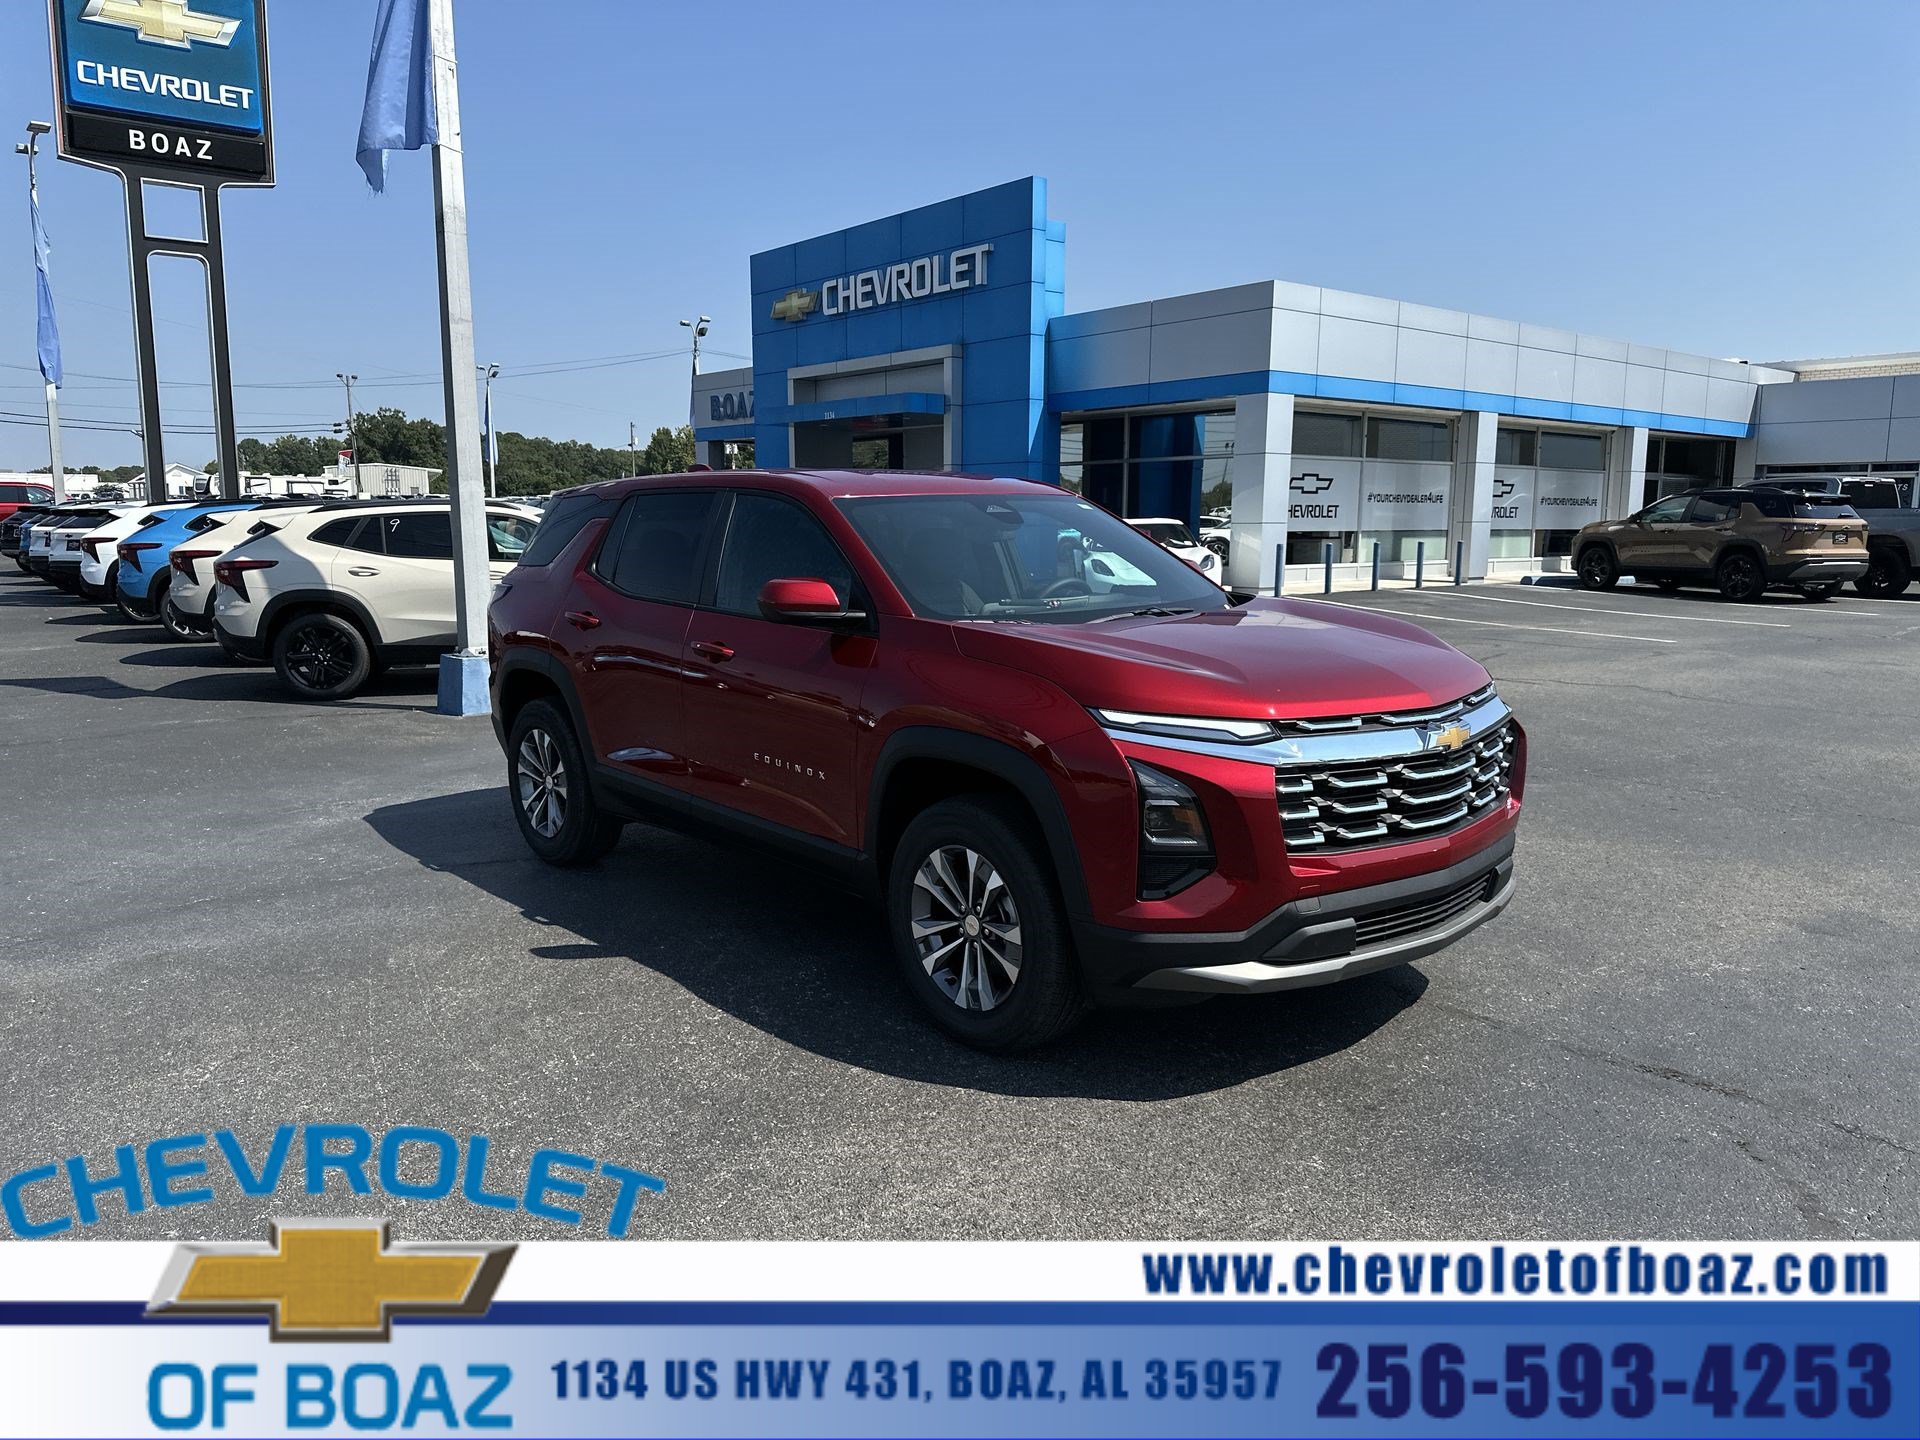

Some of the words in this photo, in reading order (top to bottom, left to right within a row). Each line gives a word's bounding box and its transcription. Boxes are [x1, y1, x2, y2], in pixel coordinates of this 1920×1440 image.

[76, 60, 254, 109] CHEVROLET
[128, 128, 213, 160] BOAZ
[822, 243, 994, 316] CHEVROLET
[390, 518, 400, 532] 9
[1288, 504, 1339, 519] HEVROLET
[754, 752, 825, 780] EQUINOX
